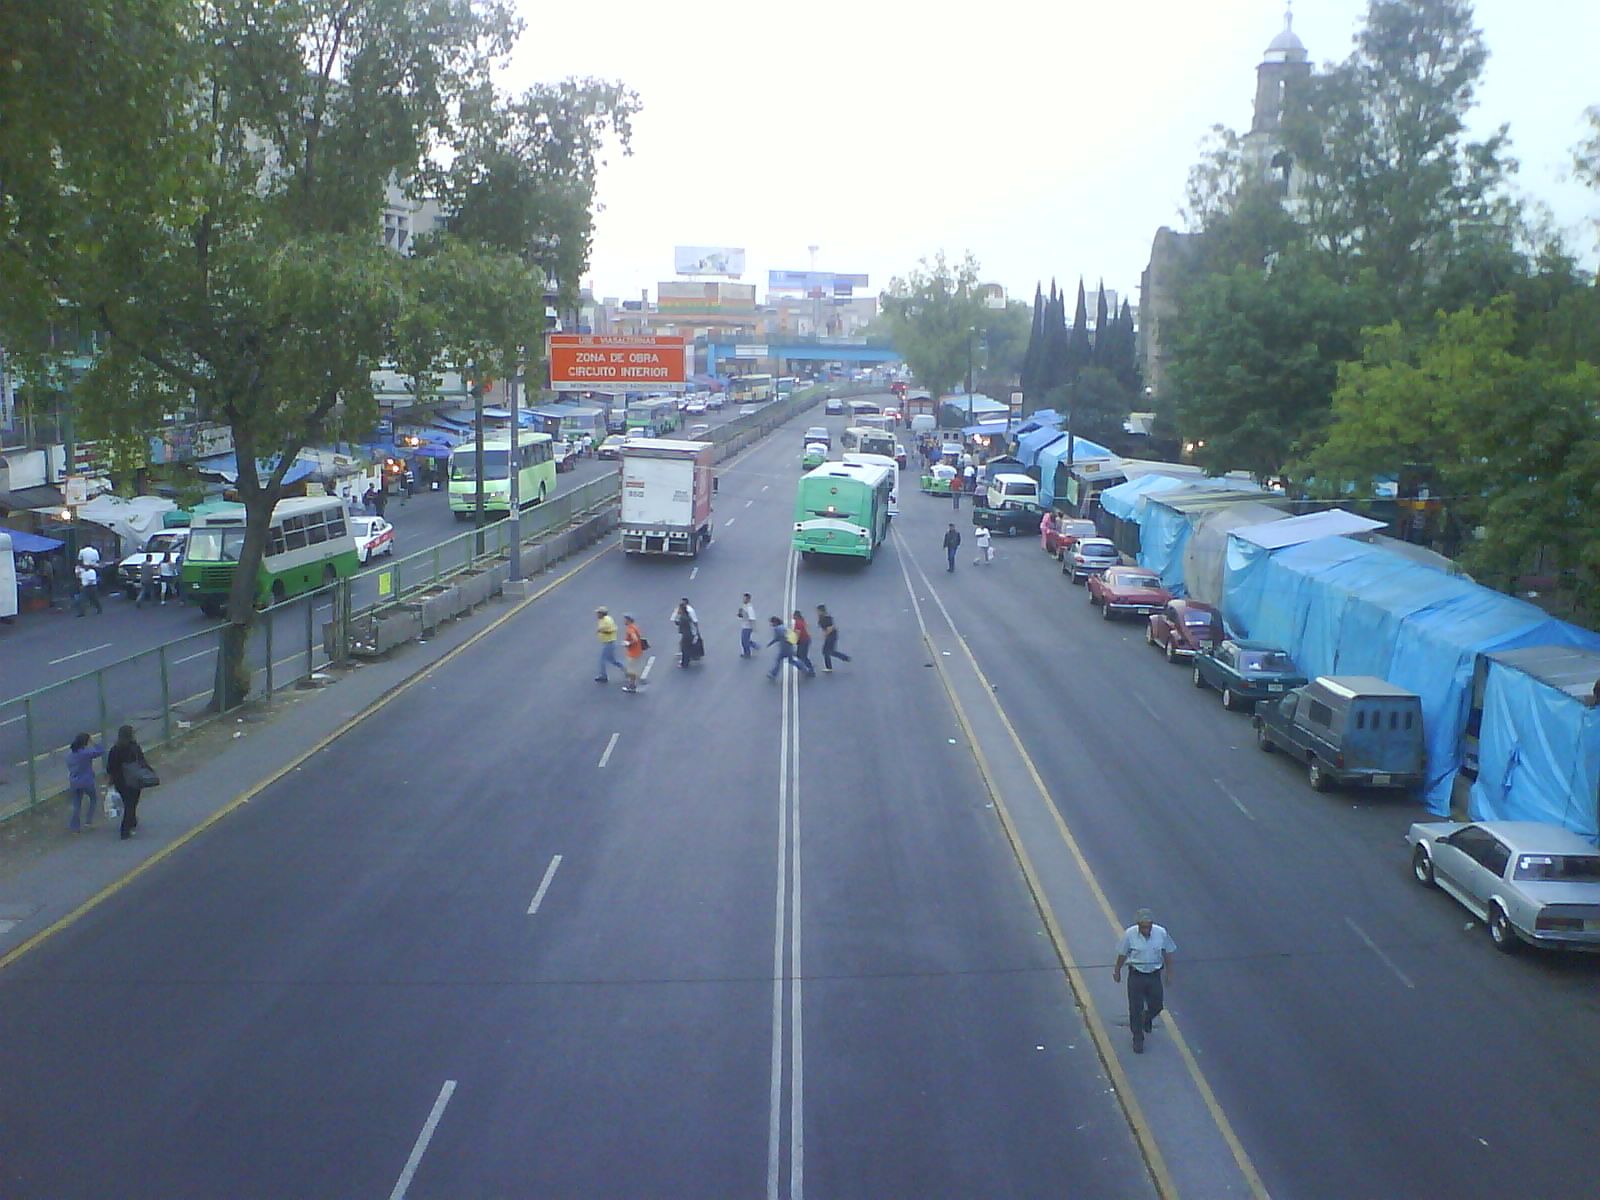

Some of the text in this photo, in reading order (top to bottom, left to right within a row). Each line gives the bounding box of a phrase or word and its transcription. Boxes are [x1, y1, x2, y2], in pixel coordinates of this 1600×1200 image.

[576, 352, 659, 363] ZONA DE OBRA
[568, 366, 668, 377] CIRCUITO INTERIOR
